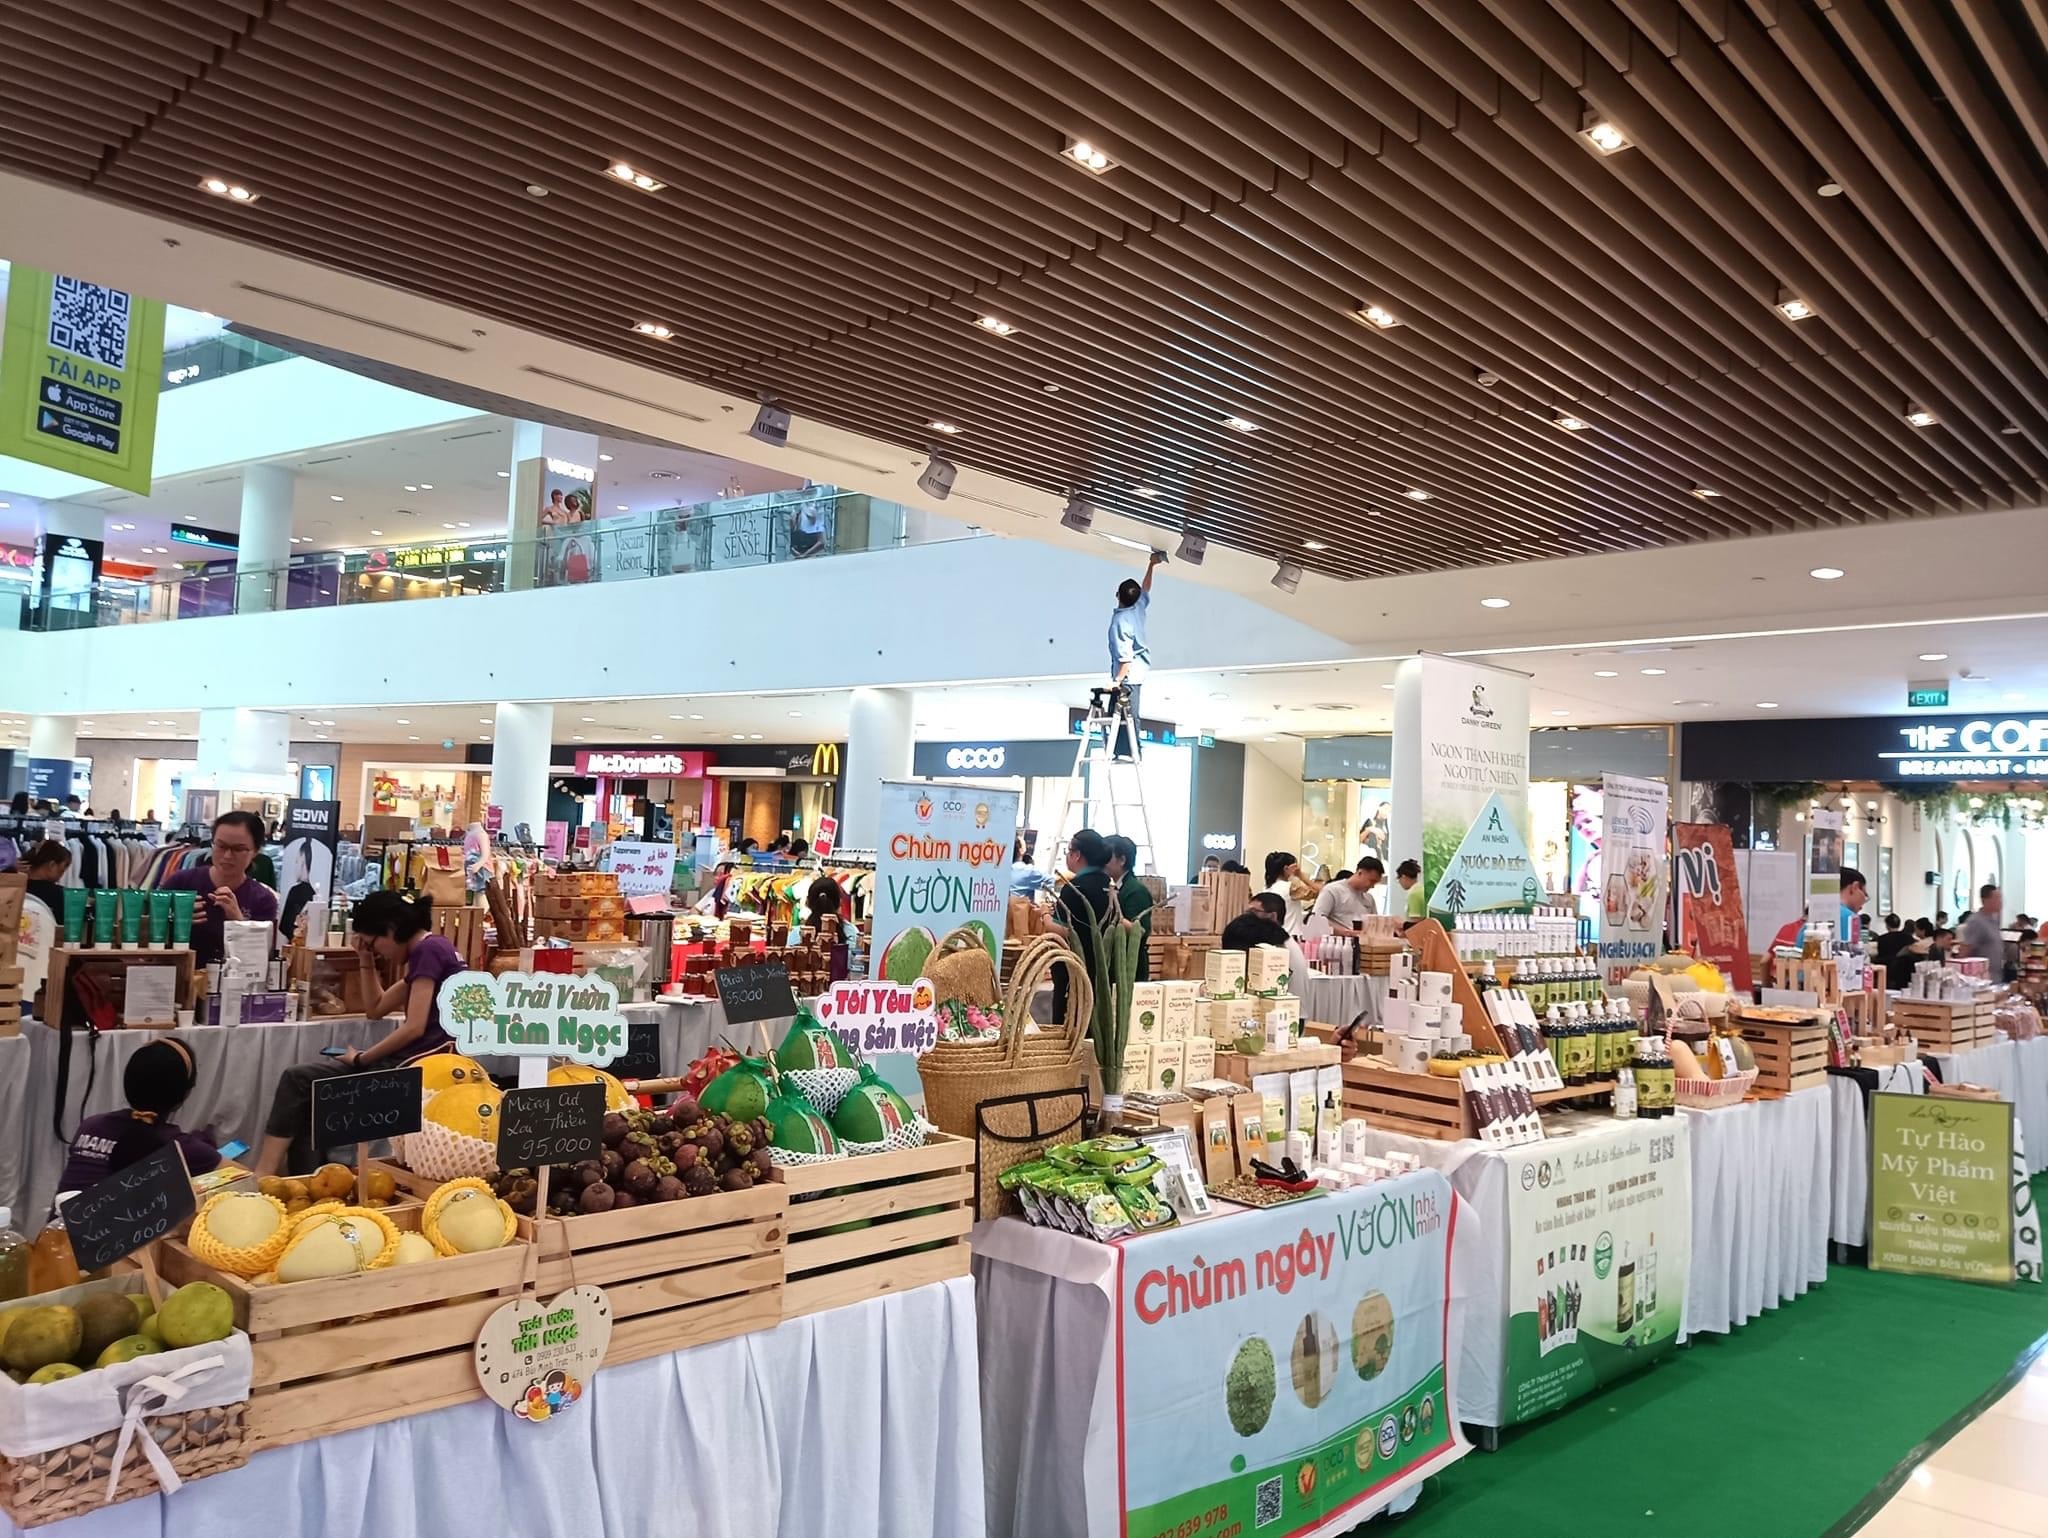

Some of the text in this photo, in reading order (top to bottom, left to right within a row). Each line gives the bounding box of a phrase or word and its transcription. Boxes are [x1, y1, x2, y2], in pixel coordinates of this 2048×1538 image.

[47, 355, 121, 394] TẢI APP
[66, 395, 116, 421] App Store
[62, 423, 116, 451] Google Play
[1917, 693, 1940, 704] EXIT
[1480, 721, 1502, 730] GREEN
[1900, 725, 1957, 751] THE
[588, 753, 684, 775] McDonald's
[1431, 742, 1462, 760] NGON
[1464, 747, 1499, 765] THANH
[1899, 759, 2012, 775] BREAKFAST
[293, 808, 329, 823] SDVN
[890, 833, 1007, 867] Chùm ngây
[888, 868, 996, 914] VƯỜN nhà
[505, 981, 610, 1011] Trái Vườn
[835, 986, 914, 1015] Tôi Yêu
[494, 1013, 549, 1044] Tâm
[557, 1015, 621, 1056] Ngọc
[864, 1016, 896, 1051] Sản
[901, 1019, 936, 1053] Việt
[518, 1137, 592, 1160] 95.000
[1896, 1128, 1986, 1153] Tự Hào
[1881, 1153, 1919, 1178] Mỹ
[1910, 1182, 1957, 1206] Việt
[1134, 1254, 1247, 1325] Chùm
[1255, 1228, 1336, 1295] ngây
[1337, 1192, 1415, 1261] VƯỜN
[1177, 1516, 1201, 1538] 639
[1204, 1504, 1228, 1529] 978
